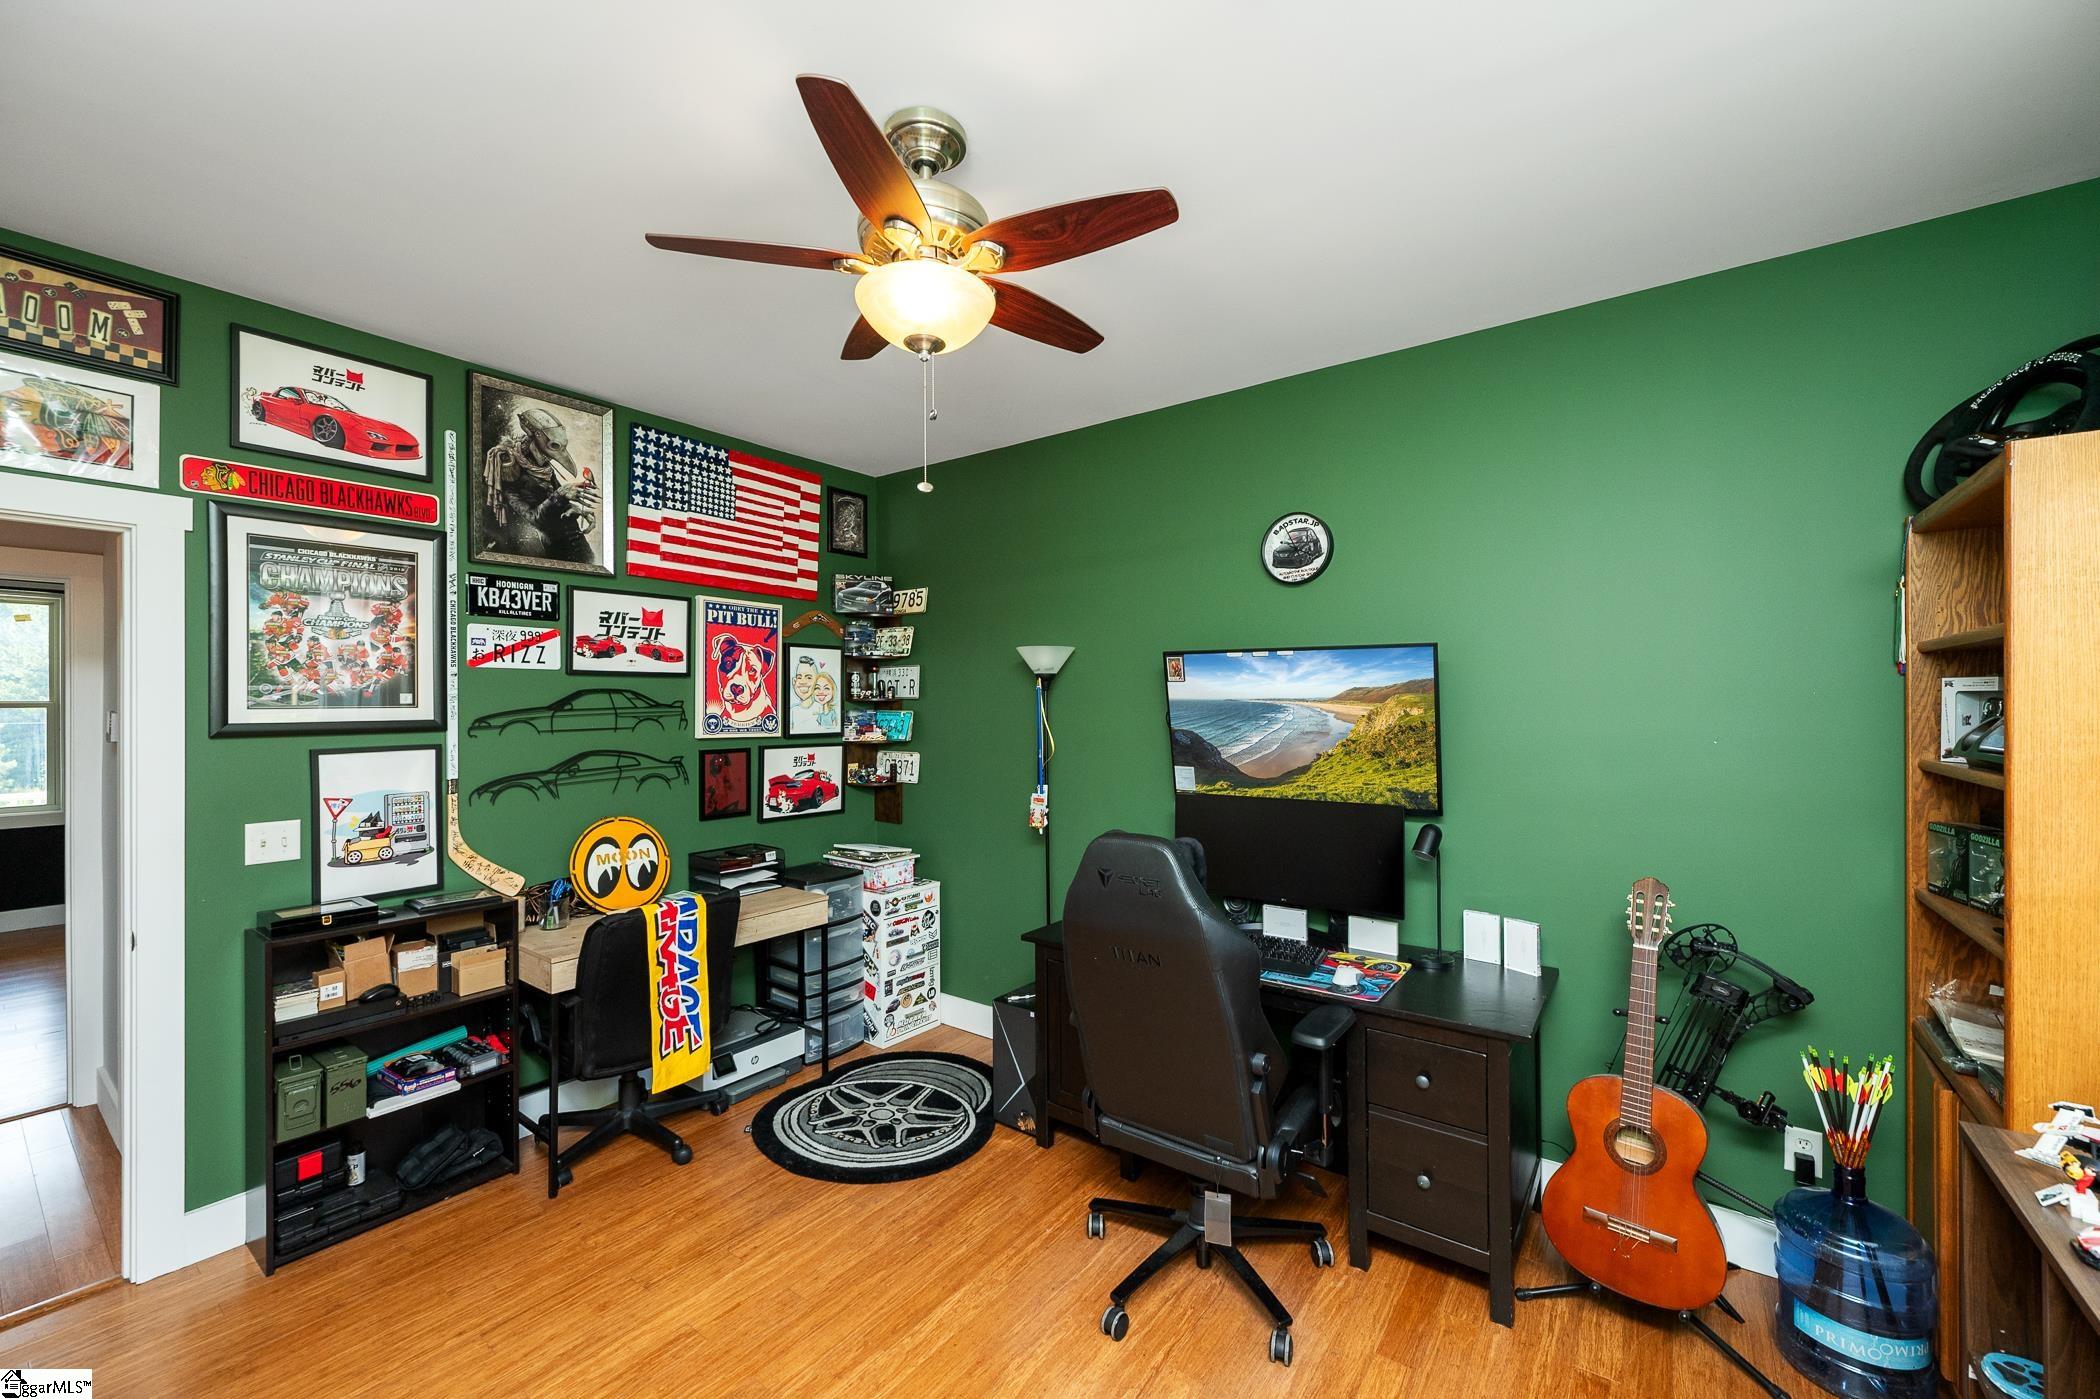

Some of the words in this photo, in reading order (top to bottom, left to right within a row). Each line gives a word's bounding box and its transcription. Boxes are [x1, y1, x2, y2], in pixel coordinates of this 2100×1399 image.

[0, 294, 110, 342] OOM
[248, 469, 315, 502] CHICAGO
[319, 481, 413, 518] BLACKHAWKS
[1273, 517, 1320, 536] BADSTAR.JP
[264, 552, 317, 564] STANLEY
[317, 557, 340, 566] CUP
[340, 560, 376, 570] FINAL
[297, 548, 328, 557] CHICAGO
[329, 551, 377, 562] BLACKHAWKS
[260, 562, 410, 602] CHAMPIONS
[496, 580, 534, 590] HOONIGAN
[835, 574, 893, 582] SKYLINE
[477, 586, 552, 612] KB43VER
[893, 589, 924, 609] 9785
[304, 618, 370, 629] CHAMPIONS
[707, 609, 734, 624] PIT
[737, 612, 777, 629] BULL!
[494, 643, 546, 665] RIZZ
[885, 758, 914, 776] C371
[1929, 822, 1955, 836] GODZILLA
[1970, 832, 2000, 847] GODZILLA
[1109, 945, 1161, 967] TITAN
[1815, 1324, 1882, 1360] PRIMO
